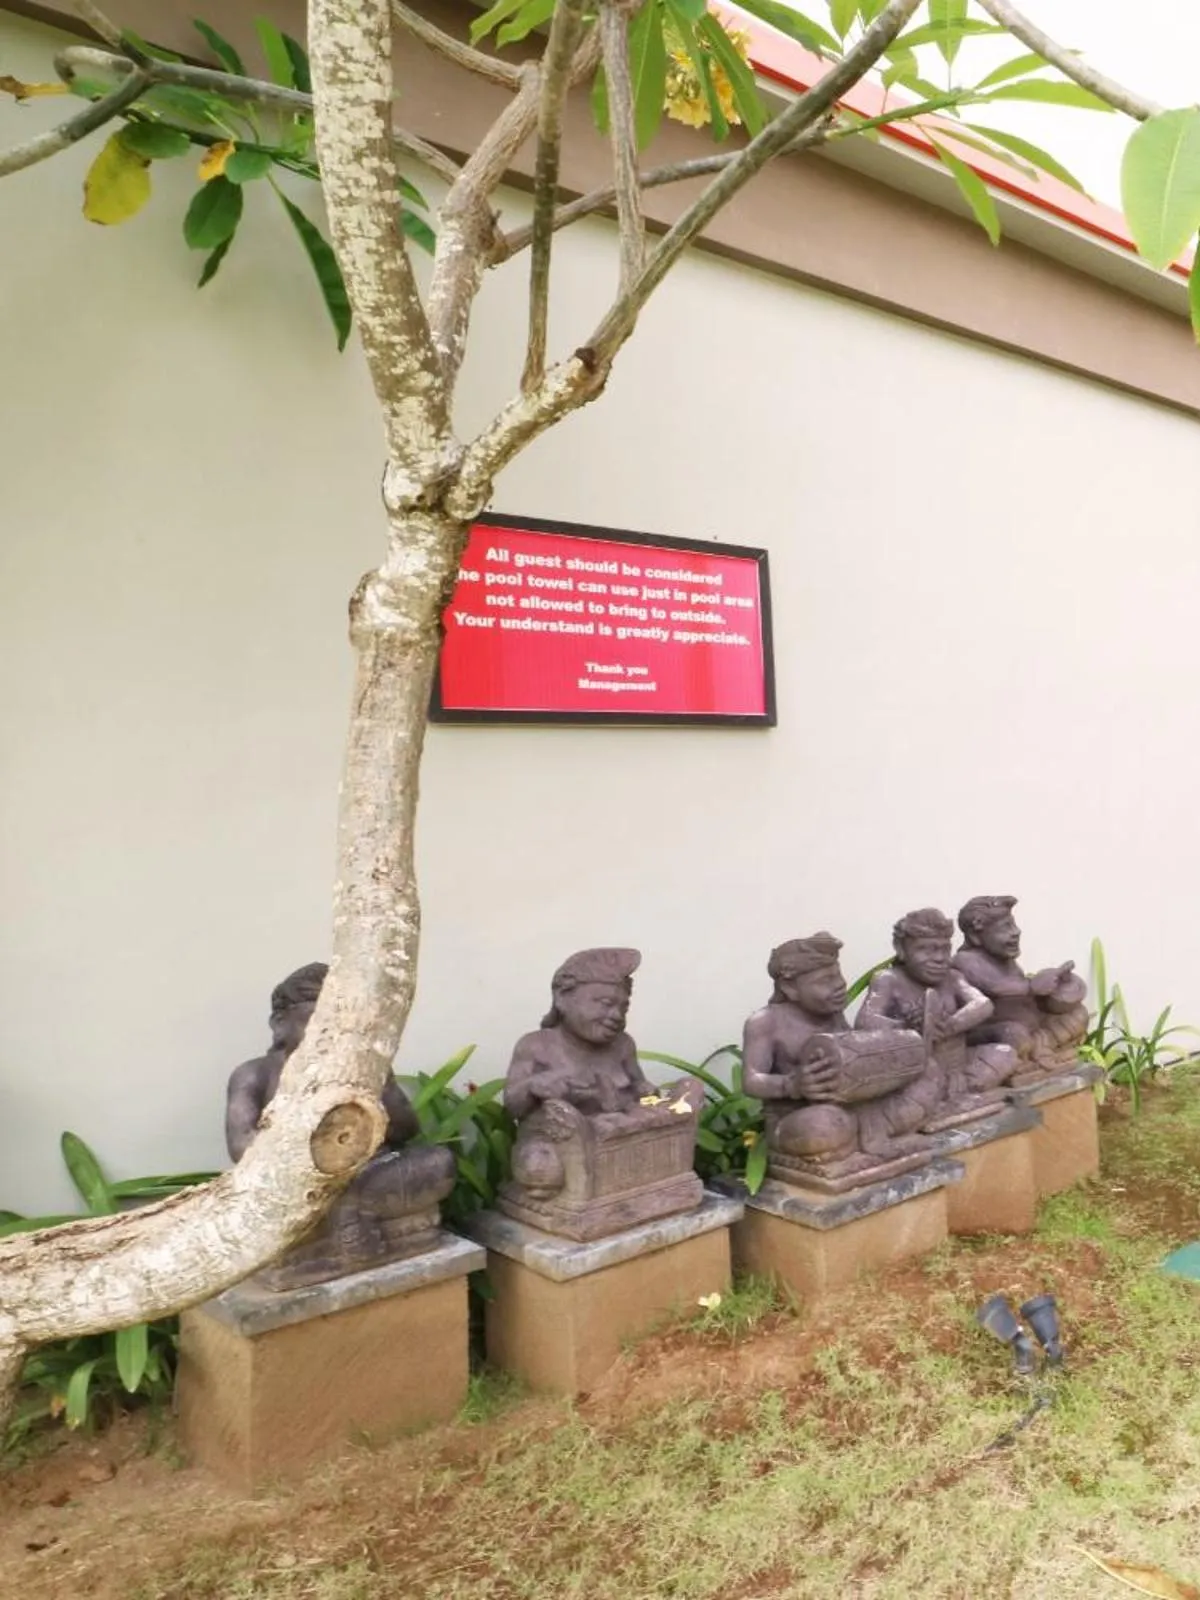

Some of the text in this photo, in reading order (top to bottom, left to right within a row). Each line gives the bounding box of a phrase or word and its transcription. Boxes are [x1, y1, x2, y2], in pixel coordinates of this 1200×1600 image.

[485, 547, 723, 585] All guest should be considered
[458, 568, 754, 608] he pool towel can use just in pool area
[485, 594, 726, 624] not allowed to bring to outside.
[453, 612, 751, 645] Your understand is greatly appreciate.
[585, 661, 649, 676] Thank you
[578, 678, 657, 692] Management
